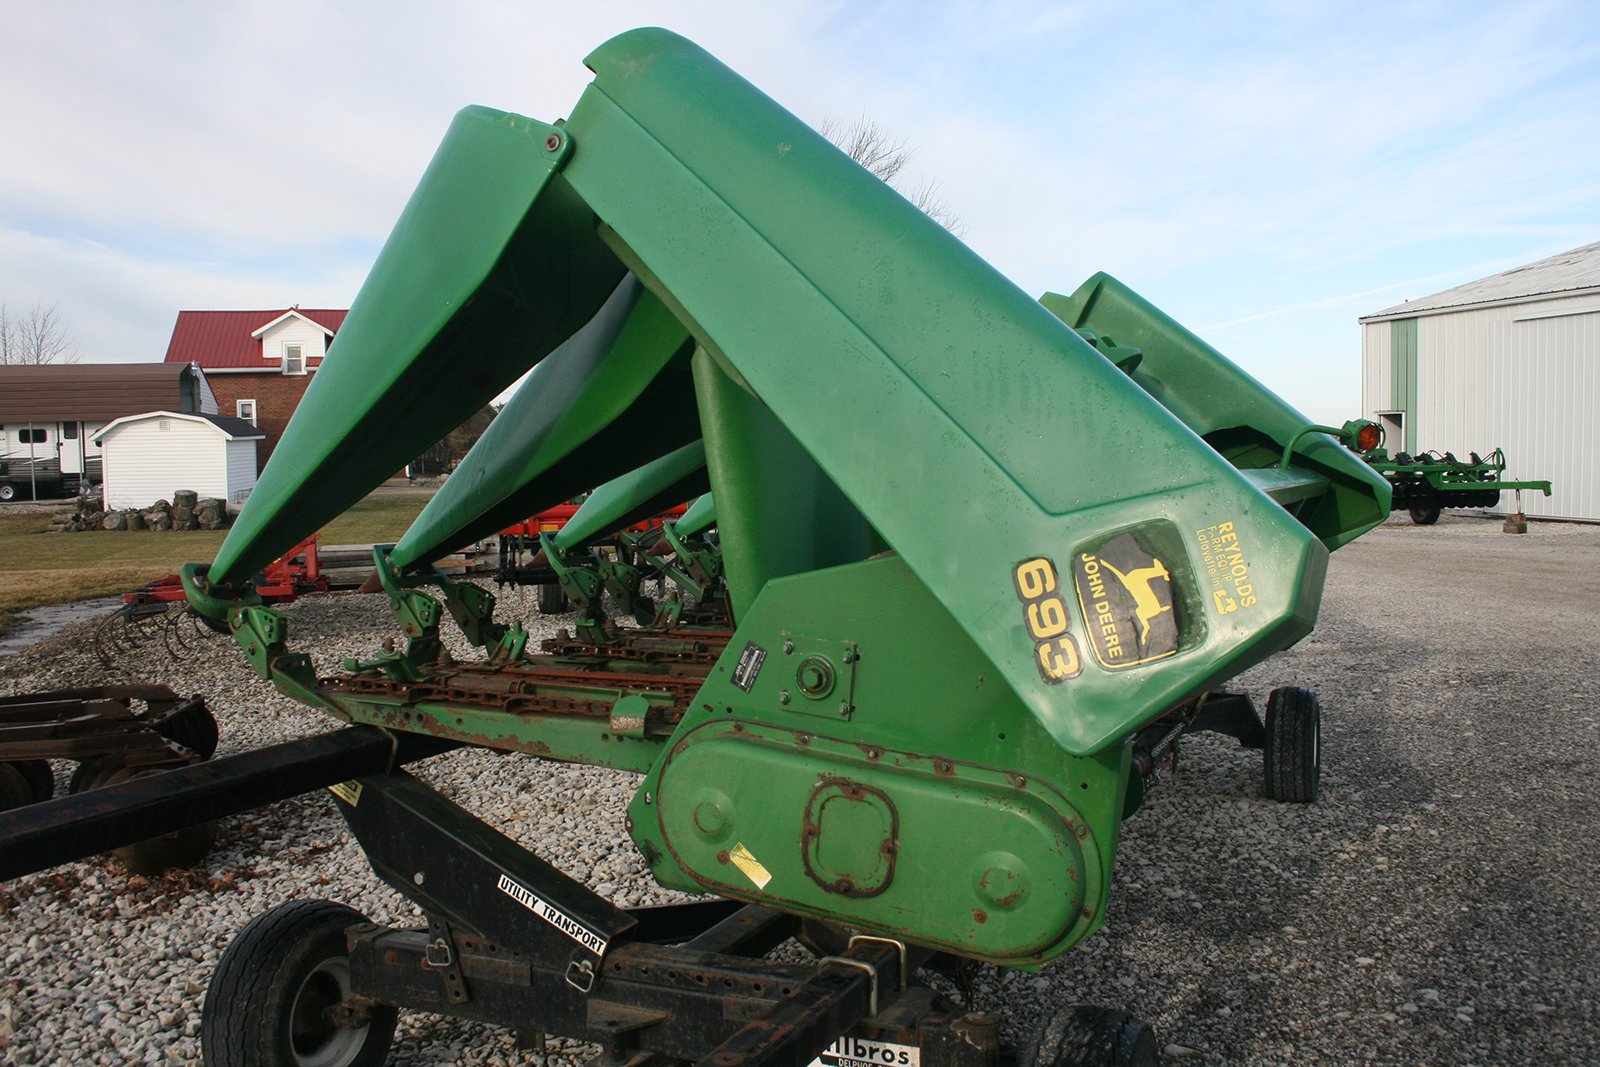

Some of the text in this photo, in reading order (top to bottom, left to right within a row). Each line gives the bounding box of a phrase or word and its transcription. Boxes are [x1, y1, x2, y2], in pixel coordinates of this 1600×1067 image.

[1081, 552, 1123, 659] JOHN DEERE
[1218, 521, 1257, 608] REYNOLDS
[1014, 557, 1081, 681] 693
[501, 877, 605, 953] UTILITY TRANSPORT
